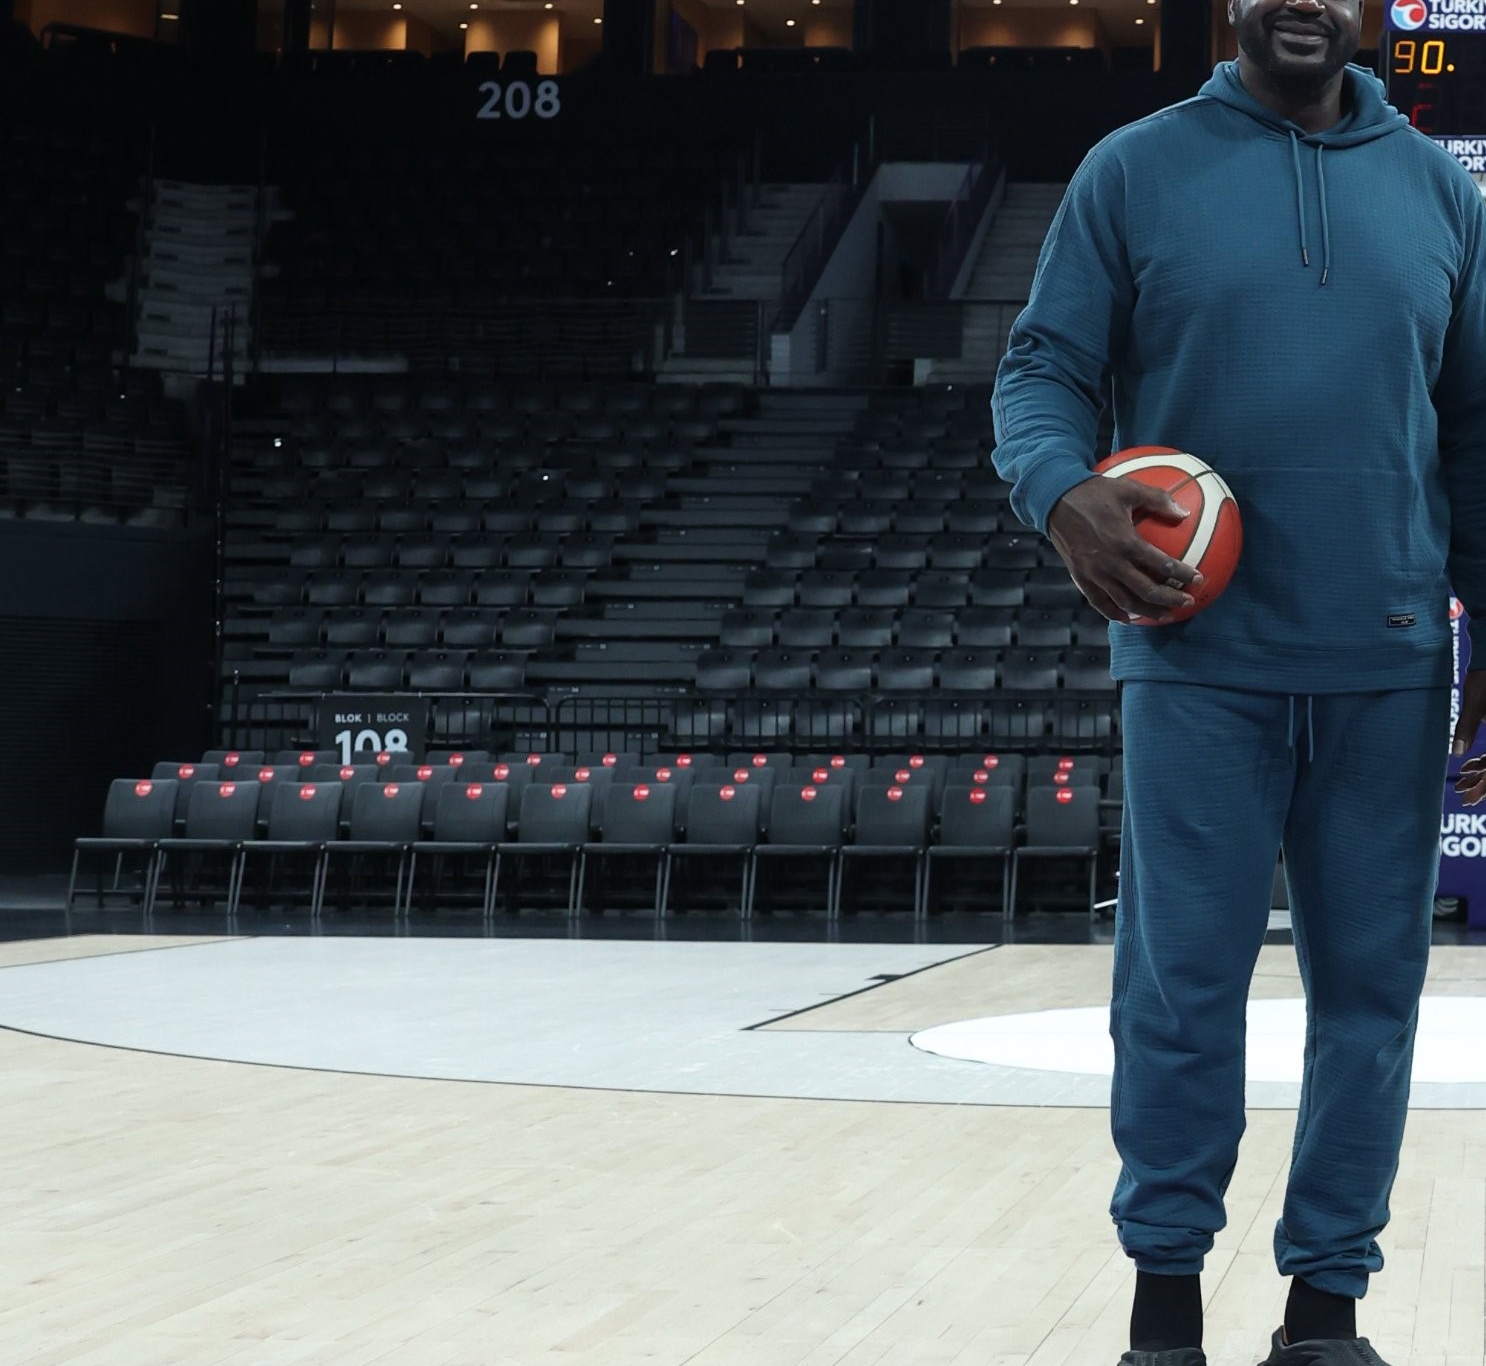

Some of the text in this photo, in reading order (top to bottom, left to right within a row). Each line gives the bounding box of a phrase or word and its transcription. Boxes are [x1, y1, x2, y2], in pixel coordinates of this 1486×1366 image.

[476, 81, 560, 119] 208
[335, 713, 409, 724] BLOK BLOCK
